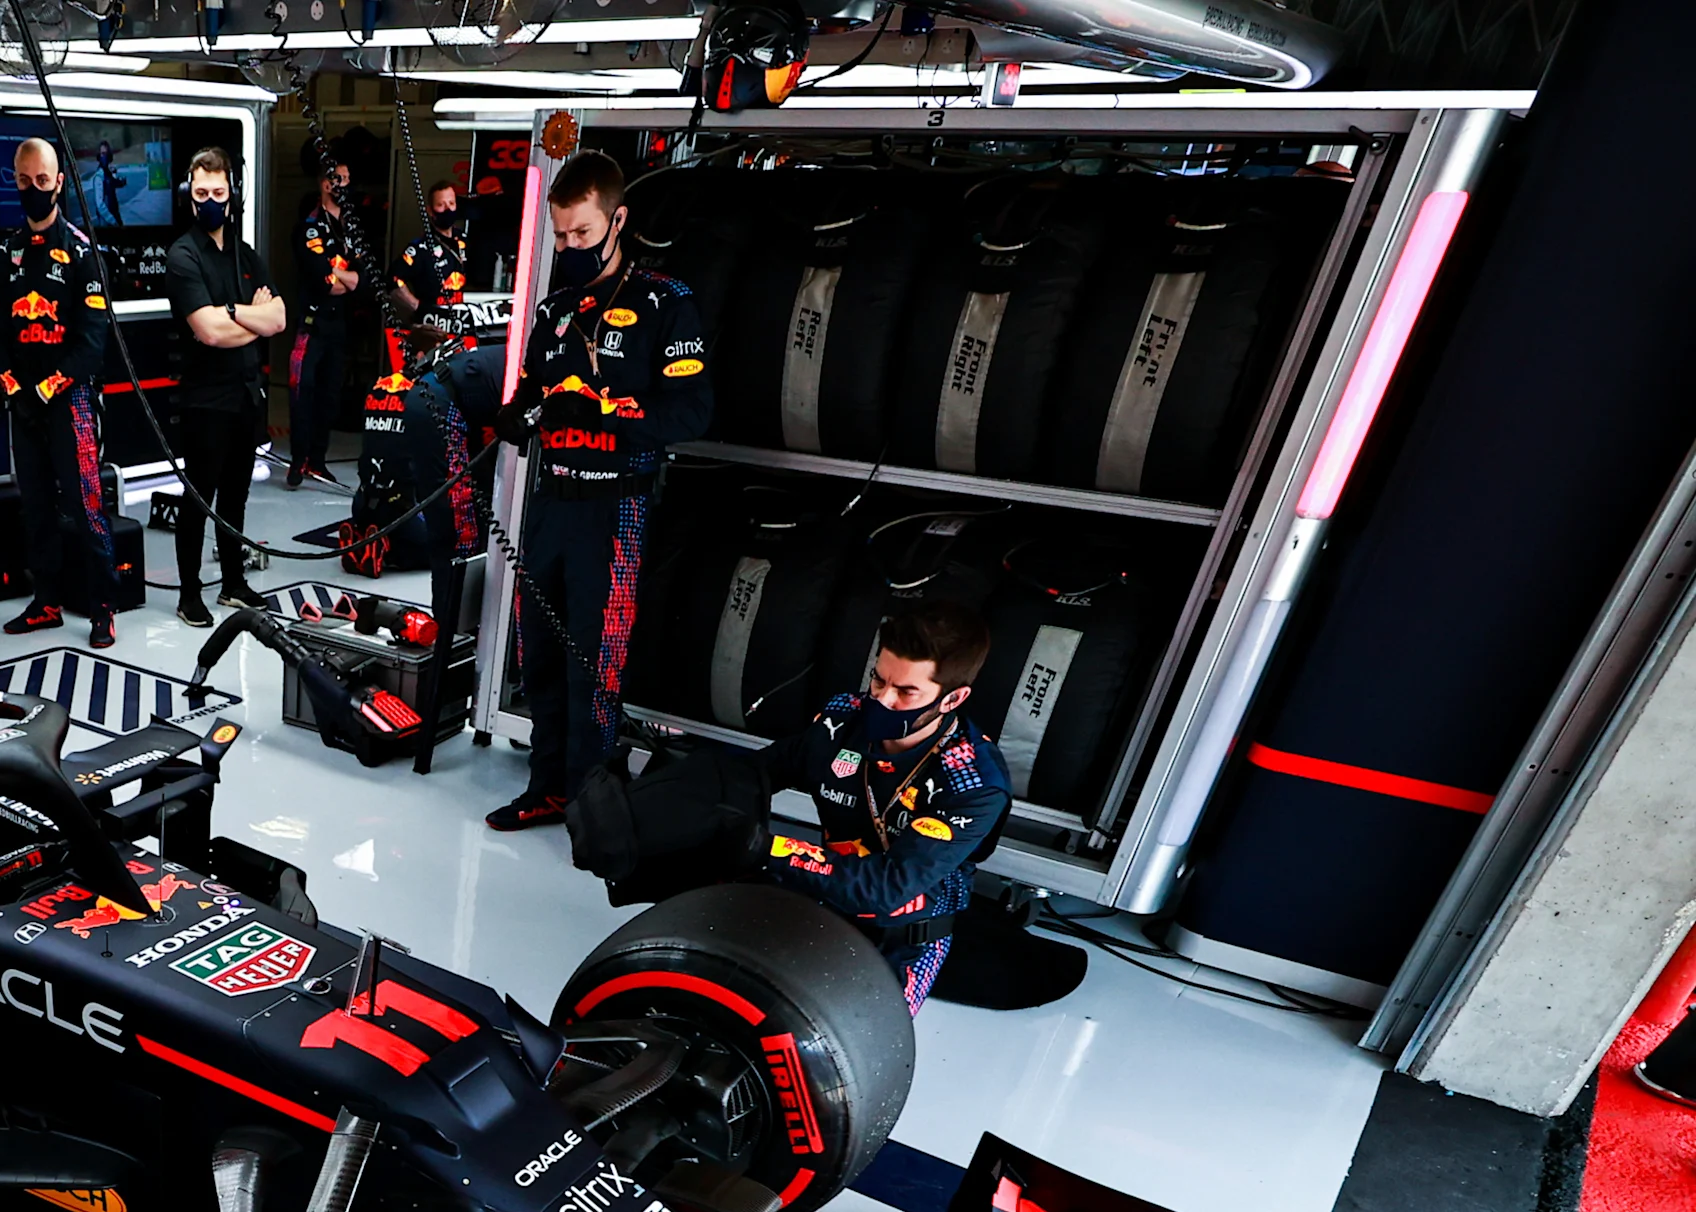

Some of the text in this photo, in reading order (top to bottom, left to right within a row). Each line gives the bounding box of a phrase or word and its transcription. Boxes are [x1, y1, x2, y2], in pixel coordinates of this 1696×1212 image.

[927, 111, 945, 127] 3
[488, 140, 530, 169] 33
[139, 261, 166, 275] Red Bu
[664, 337, 704, 357] citrix
[793, 306, 811, 351] Left
[804, 310, 822, 360] Rear
[1134, 313, 1163, 368] Left
[950, 334, 975, 392] Right
[963, 338, 988, 396] Front
[364, 416, 393, 431] Mobil
[729, 577, 746, 613] Left
[738, 582, 757, 622] Rear
[1021, 661, 1042, 705] Left
[1029, 667, 1058, 719] Front
[95, 749, 171, 777] Walmart
[790, 855, 833, 876] Red Bull
[124, 903, 256, 970] HONDA
[185, 926, 274, 976] TAG
[216, 942, 305, 992] HEUER
[299, 979, 481, 1078] 11
[760, 1032, 825, 1154] PIRELLI
[514, 1128, 582, 1188] ORACLE
